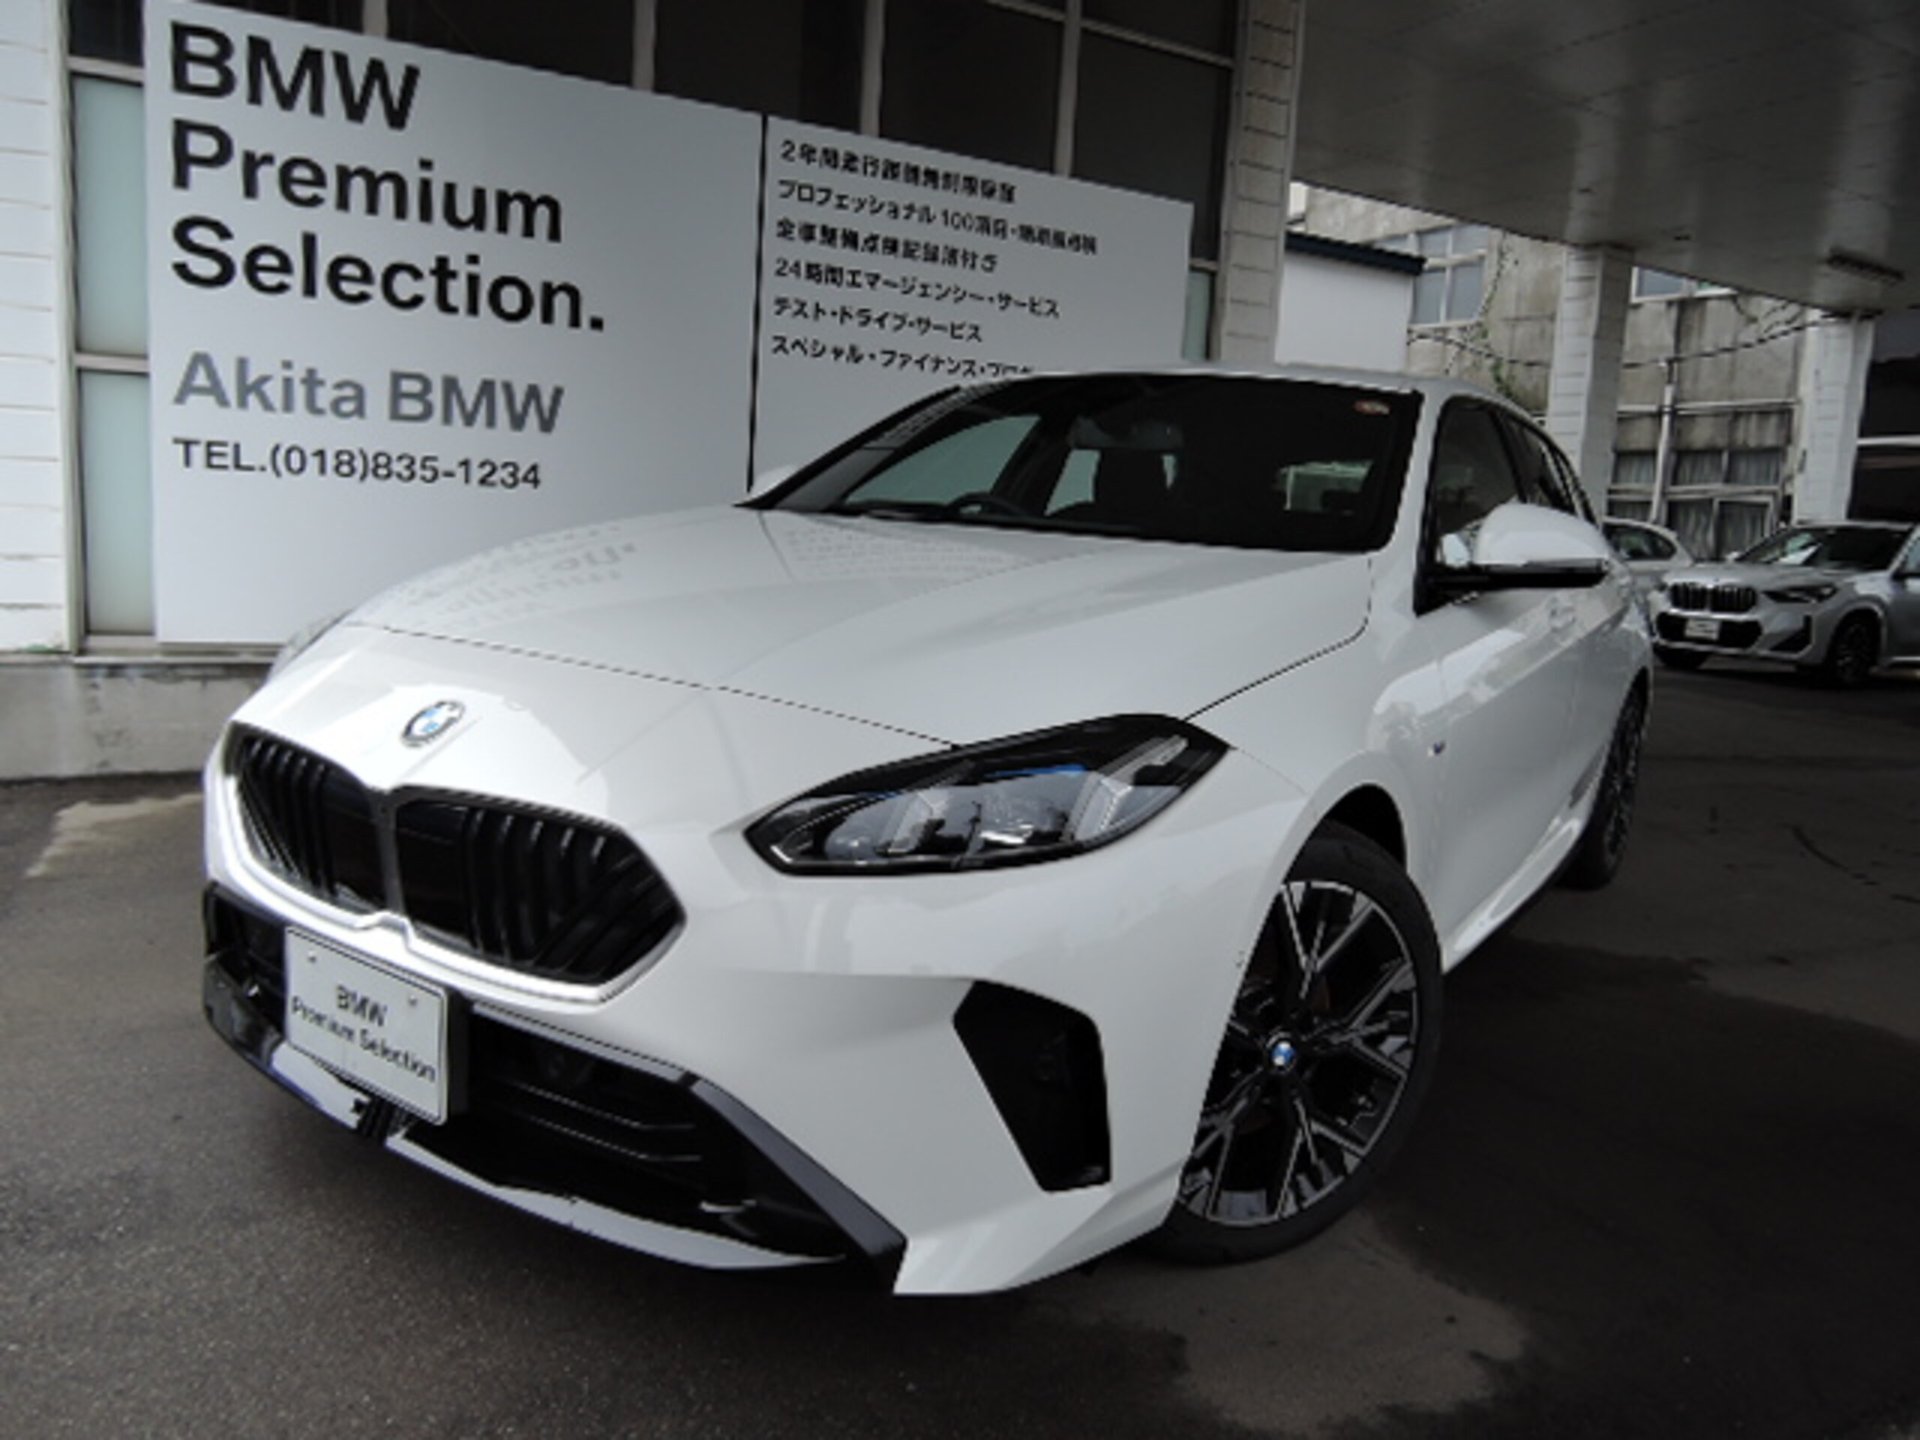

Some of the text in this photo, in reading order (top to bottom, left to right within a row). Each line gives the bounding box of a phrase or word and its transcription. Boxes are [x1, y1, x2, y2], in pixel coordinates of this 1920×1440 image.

[170, 20, 420, 131] BMW
[172, 119, 562, 243] Premium
[171, 215, 605, 332] Selection.
[172, 351, 564, 433] Akita BMW
[172, 437, 542, 490] TEL.(018)835-1234
